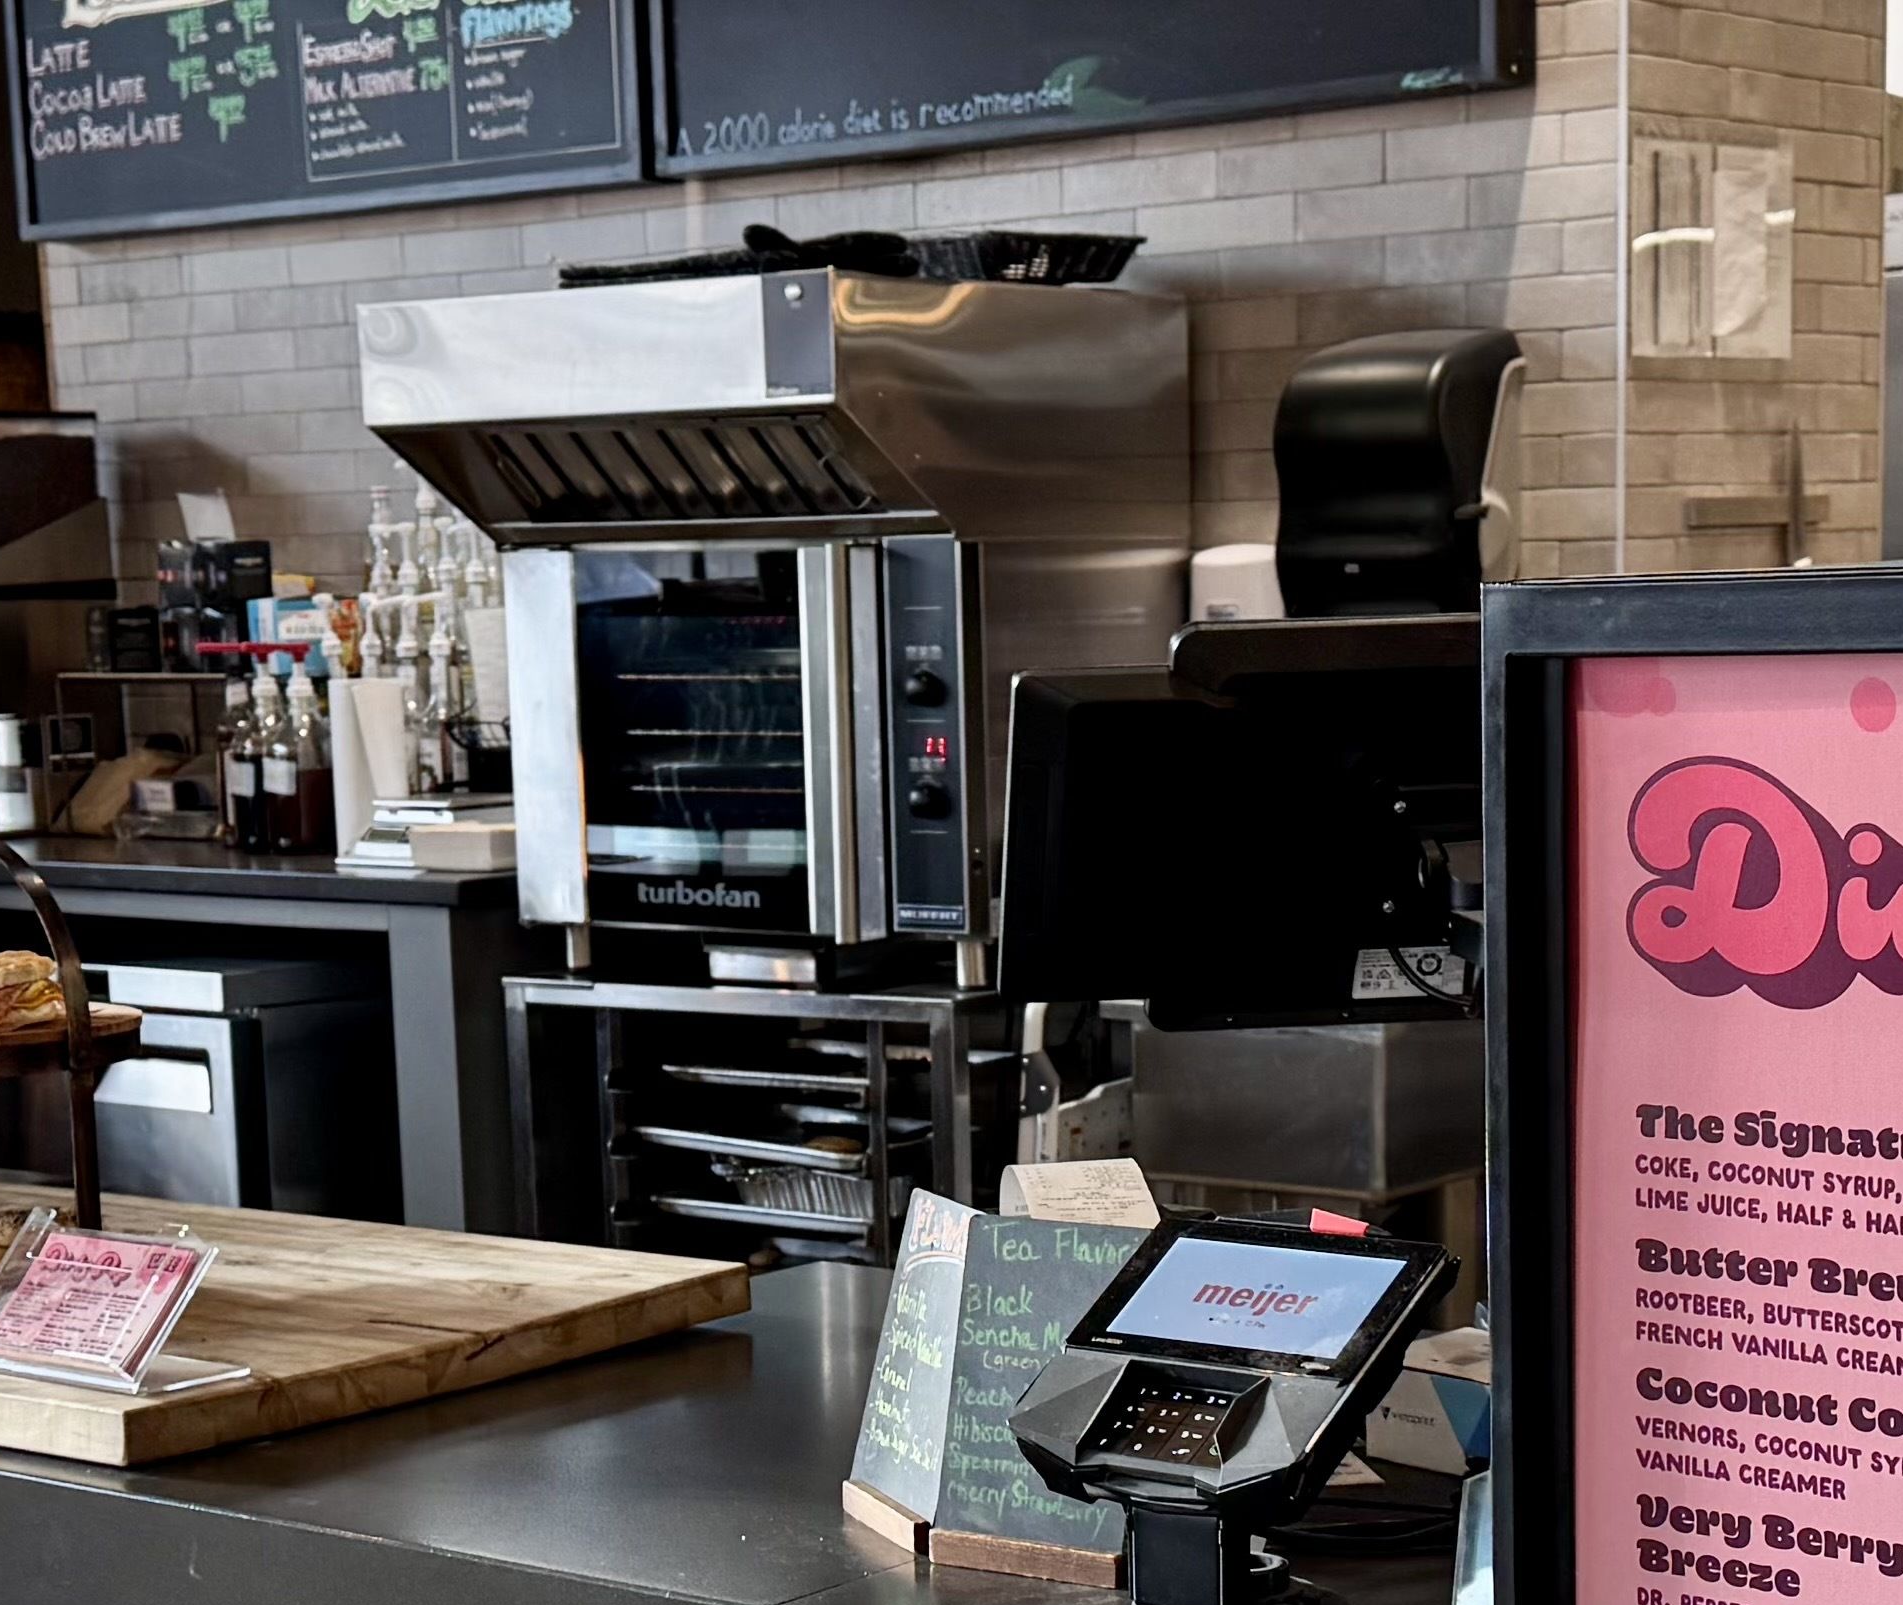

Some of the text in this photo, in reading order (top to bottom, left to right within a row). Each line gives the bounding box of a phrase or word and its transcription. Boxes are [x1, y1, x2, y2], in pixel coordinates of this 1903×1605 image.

[675, 75, 1074, 156] A 2000 calorie diet is recommended
[637, 881, 761, 909] turbofan
[1635, 1103, 1725, 1144] The
[1634, 1153, 1903, 1205] COKE, COCONUT SYRUP,
[1635, 1187, 1689, 1212] LIME
[1696, 1192, 1768, 1224] JUICE,
[1776, 1200, 1834, 1228] HALF
[1842, 1208, 1857, 1230] &
[983, 1221, 1042, 1263] Tea
[1054, 1227, 1139, 1266] Flavor
[1634, 1237, 1799, 1288] Butter
[966, 1284, 1033, 1317] Black
[1193, 1282, 1319, 1317] meijer
[1635, 1287, 1755, 1325] ROOTBEER,
[961, 1318, 1040, 1350] Sencha
[955, 1375, 1013, 1407] Peach
[1635, 1366, 1839, 1427] Coconut
[1636, 1493, 1753, 1549] Very
[1636, 1537, 1801, 1598] Breeze
